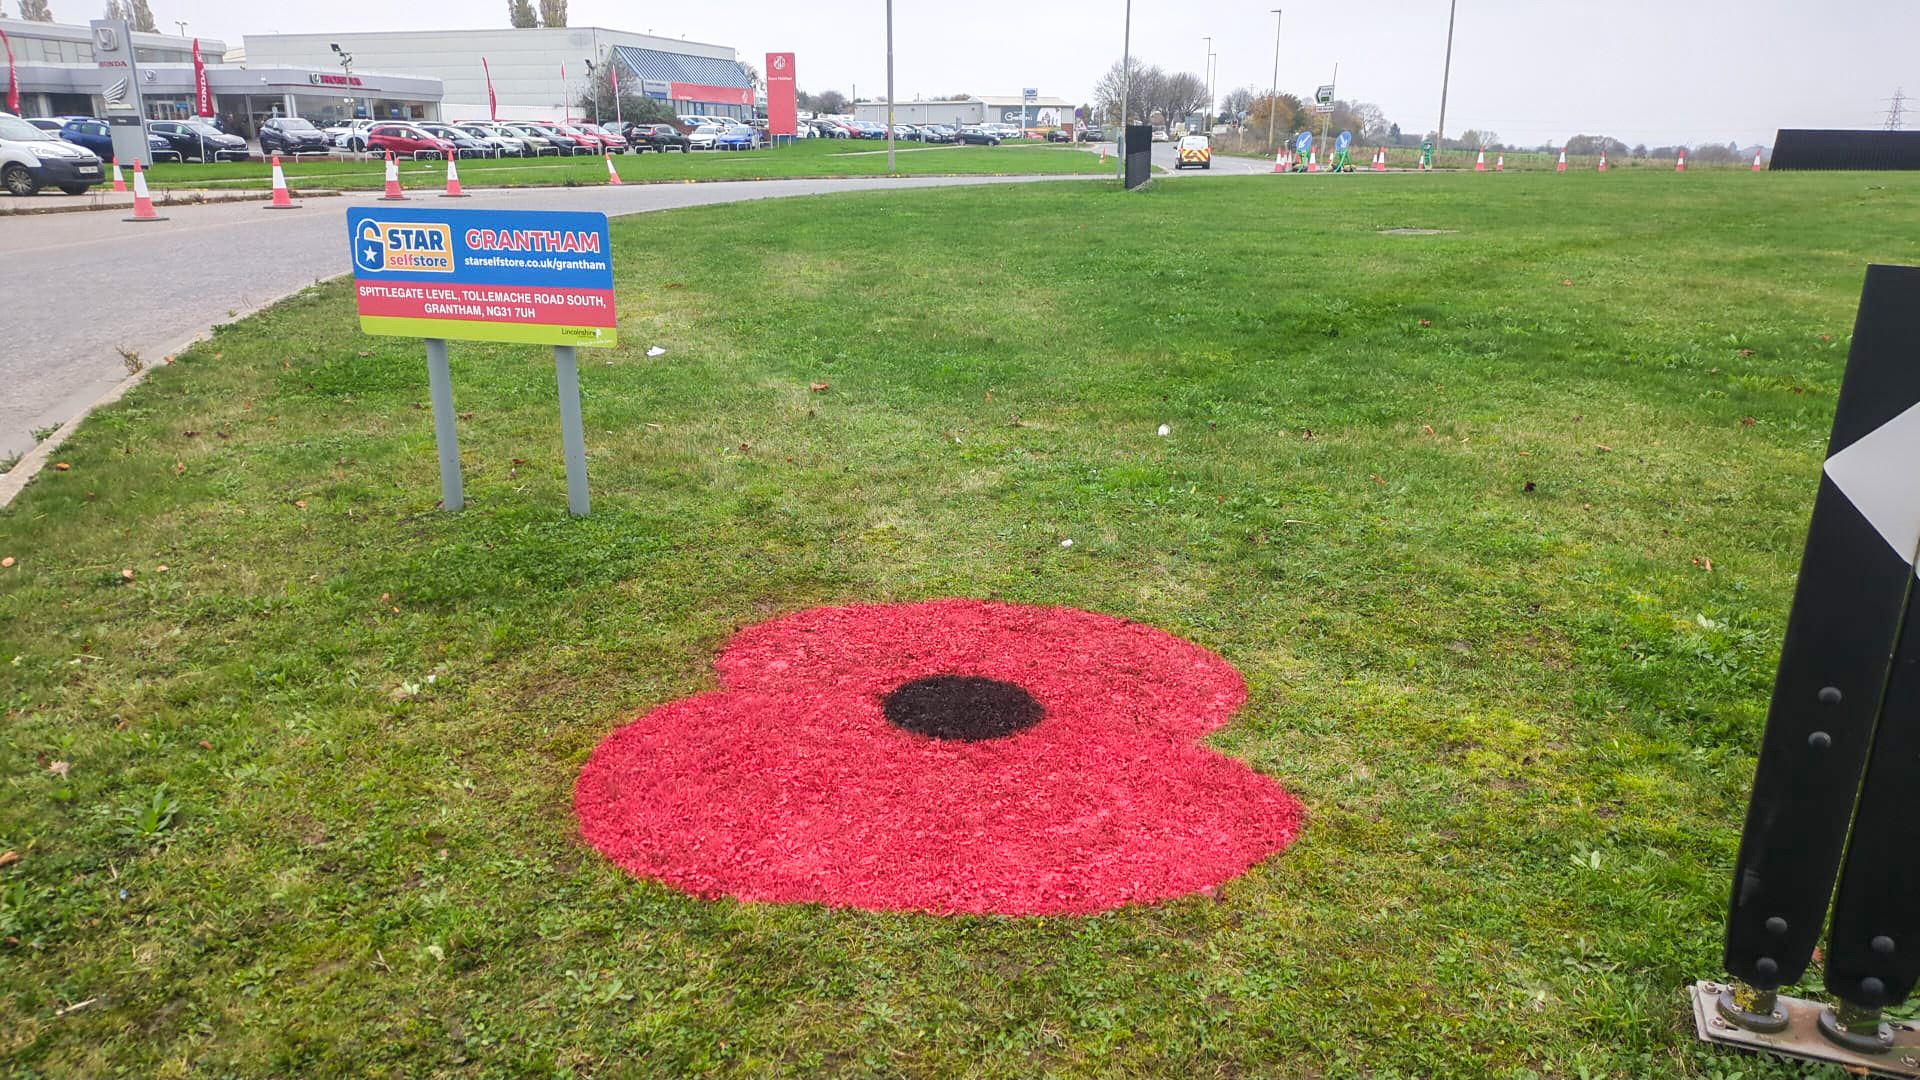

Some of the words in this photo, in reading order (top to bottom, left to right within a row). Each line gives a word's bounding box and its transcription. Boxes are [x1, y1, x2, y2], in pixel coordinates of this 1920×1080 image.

[387, 228, 445, 251] STAR
[465, 229, 600, 253] GRANTHAM
[390, 254, 448, 267] selfstore
[464, 256, 606, 271] starselfstore.co.uk/grantham
[359, 286, 424, 299] SPITTLEGATE
[425, 289, 461, 302] LEVEL,
[462, 290, 531, 304] TOLLEMACHE
[534, 293, 565, 305] ROAD
[567, 294, 607, 309] SOUTH,
[424, 303, 485, 317] GRANTHAM,
[486, 305, 512, 317] NG31
[514, 307, 536, 318] 7UH
